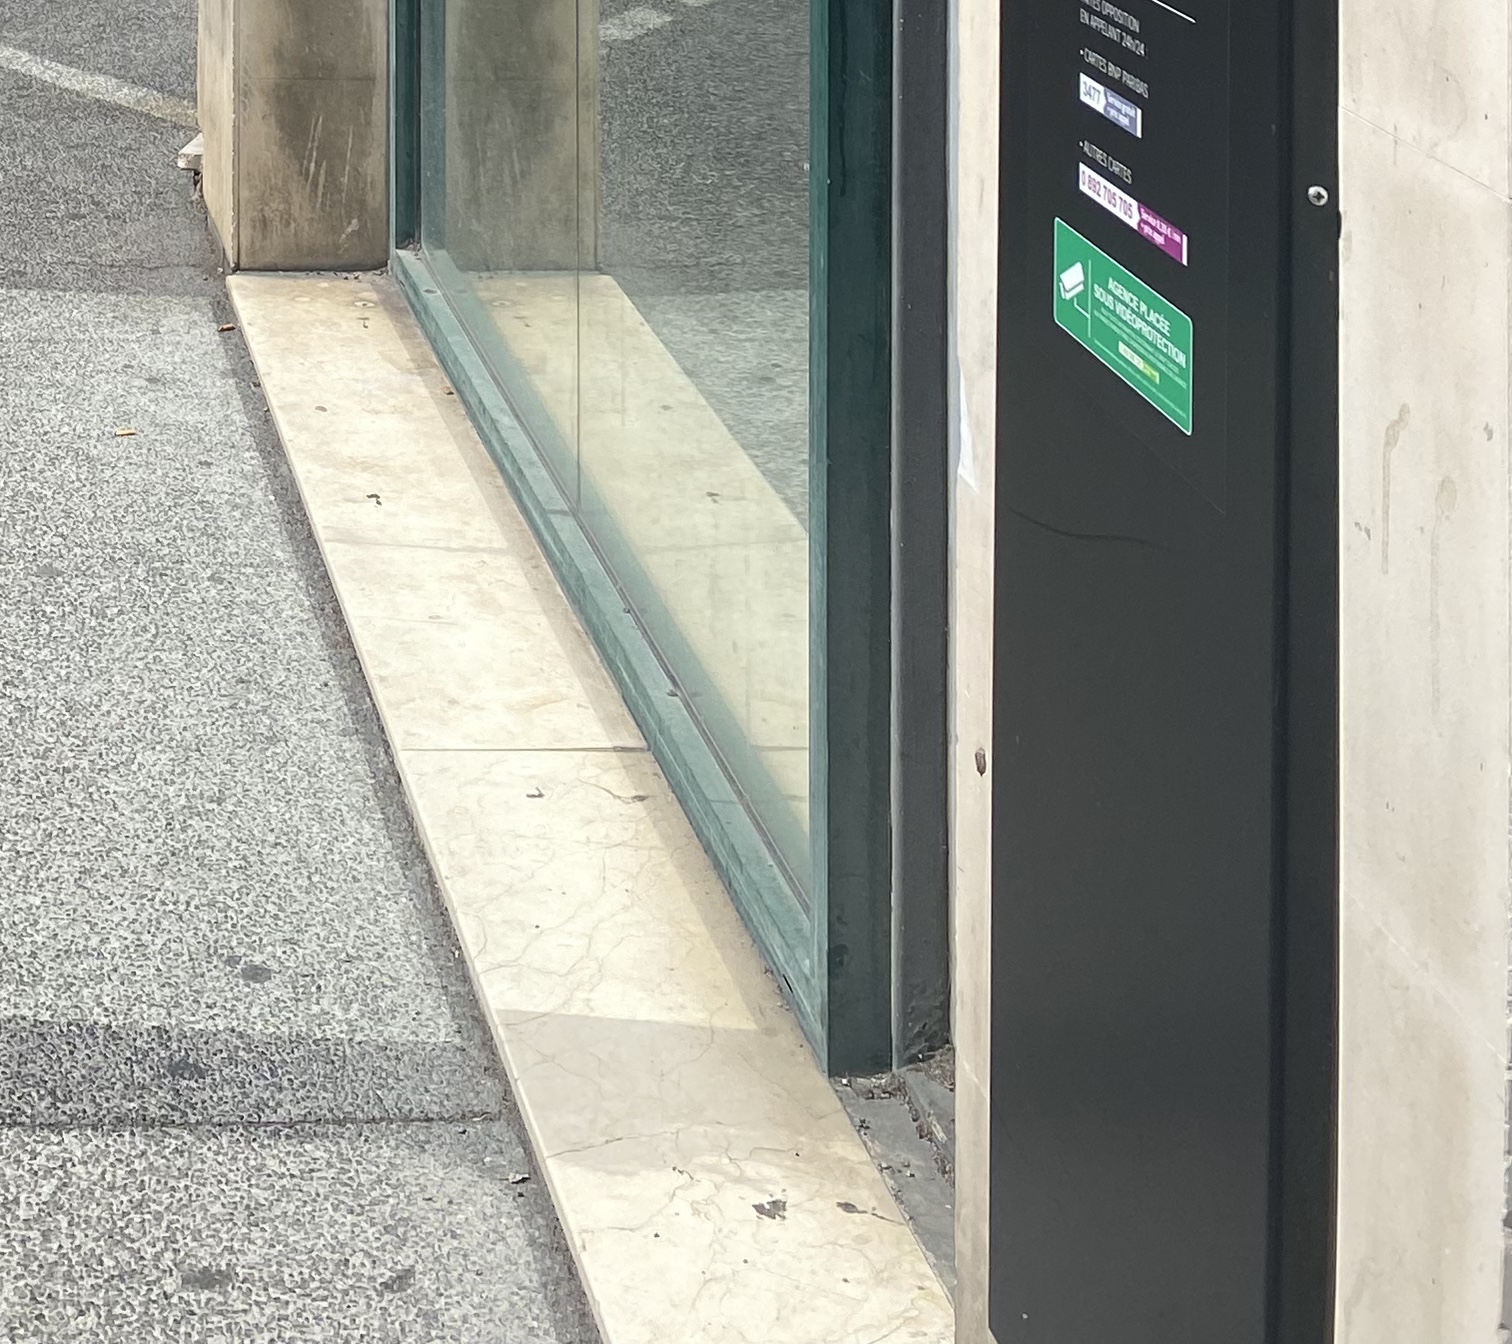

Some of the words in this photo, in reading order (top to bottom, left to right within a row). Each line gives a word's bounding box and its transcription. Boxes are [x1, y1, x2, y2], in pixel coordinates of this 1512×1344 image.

[1080, 8, 1089, 25] EN
[1102, 0, 1139, 33] OPPOSITION
[1084, 48, 1107, 73] CARTES
[1084, 140, 1107, 167] AUTRES
[1108, 156, 1131, 184] CARTES
[1088, 175, 1101, 197] 892
[1103, 185, 1116, 208] 705
[1118, 196, 1132, 219] 705
[1094, 284, 1114, 310] SOUS
[1115, 300, 1186, 368] VIDÉOPROTECTION
[1108, 277, 1139, 312] AGENCE
[1140, 301, 1170, 336] PLACÉE
